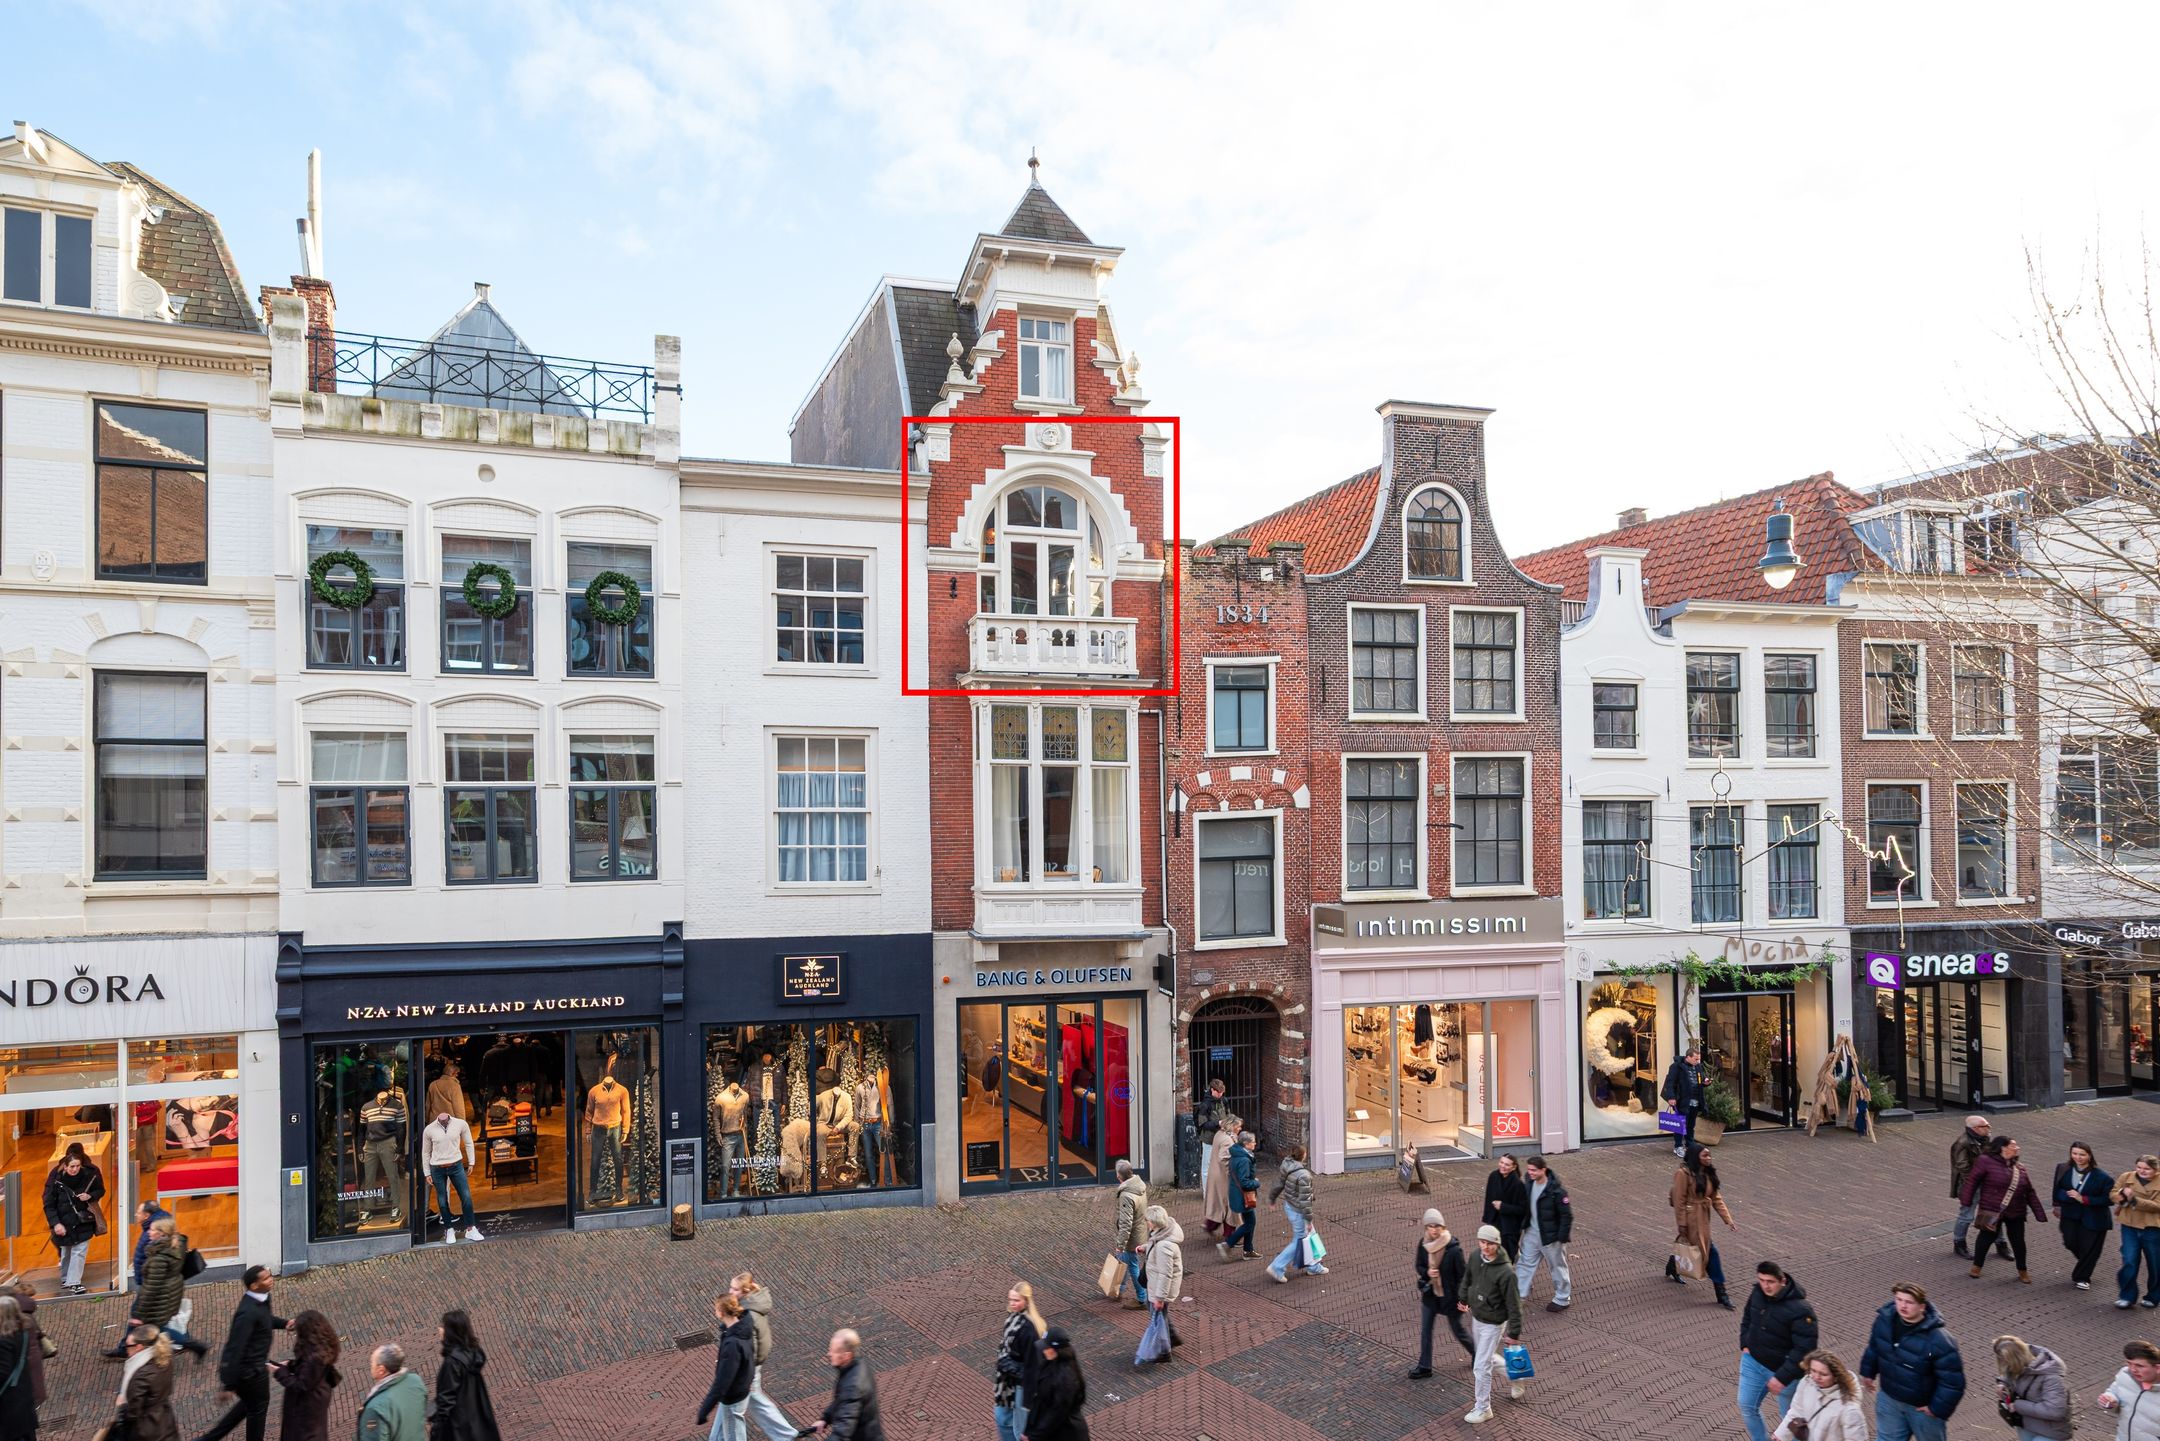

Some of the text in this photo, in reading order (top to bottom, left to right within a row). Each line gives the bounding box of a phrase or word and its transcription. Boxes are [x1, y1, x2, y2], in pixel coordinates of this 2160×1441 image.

[1216, 604, 1269, 624] 1834
[1357, 916, 1527, 937] intimissimi
[2055, 927, 2104, 945] Gabor
[976, 966, 1132, 987] BANG & OLUFSEN
[396, 1005, 436, 1017] NEW
[445, 1001, 525, 1015] ZEALAND
[533, 996, 626, 1011] AUCKLAND
[291, 1115, 298, 1123] 5
[731, 1156, 764, 1165] WINTER
[337, 1190, 364, 1198] WINTER
[365, 1188, 382, 1197] SALE
